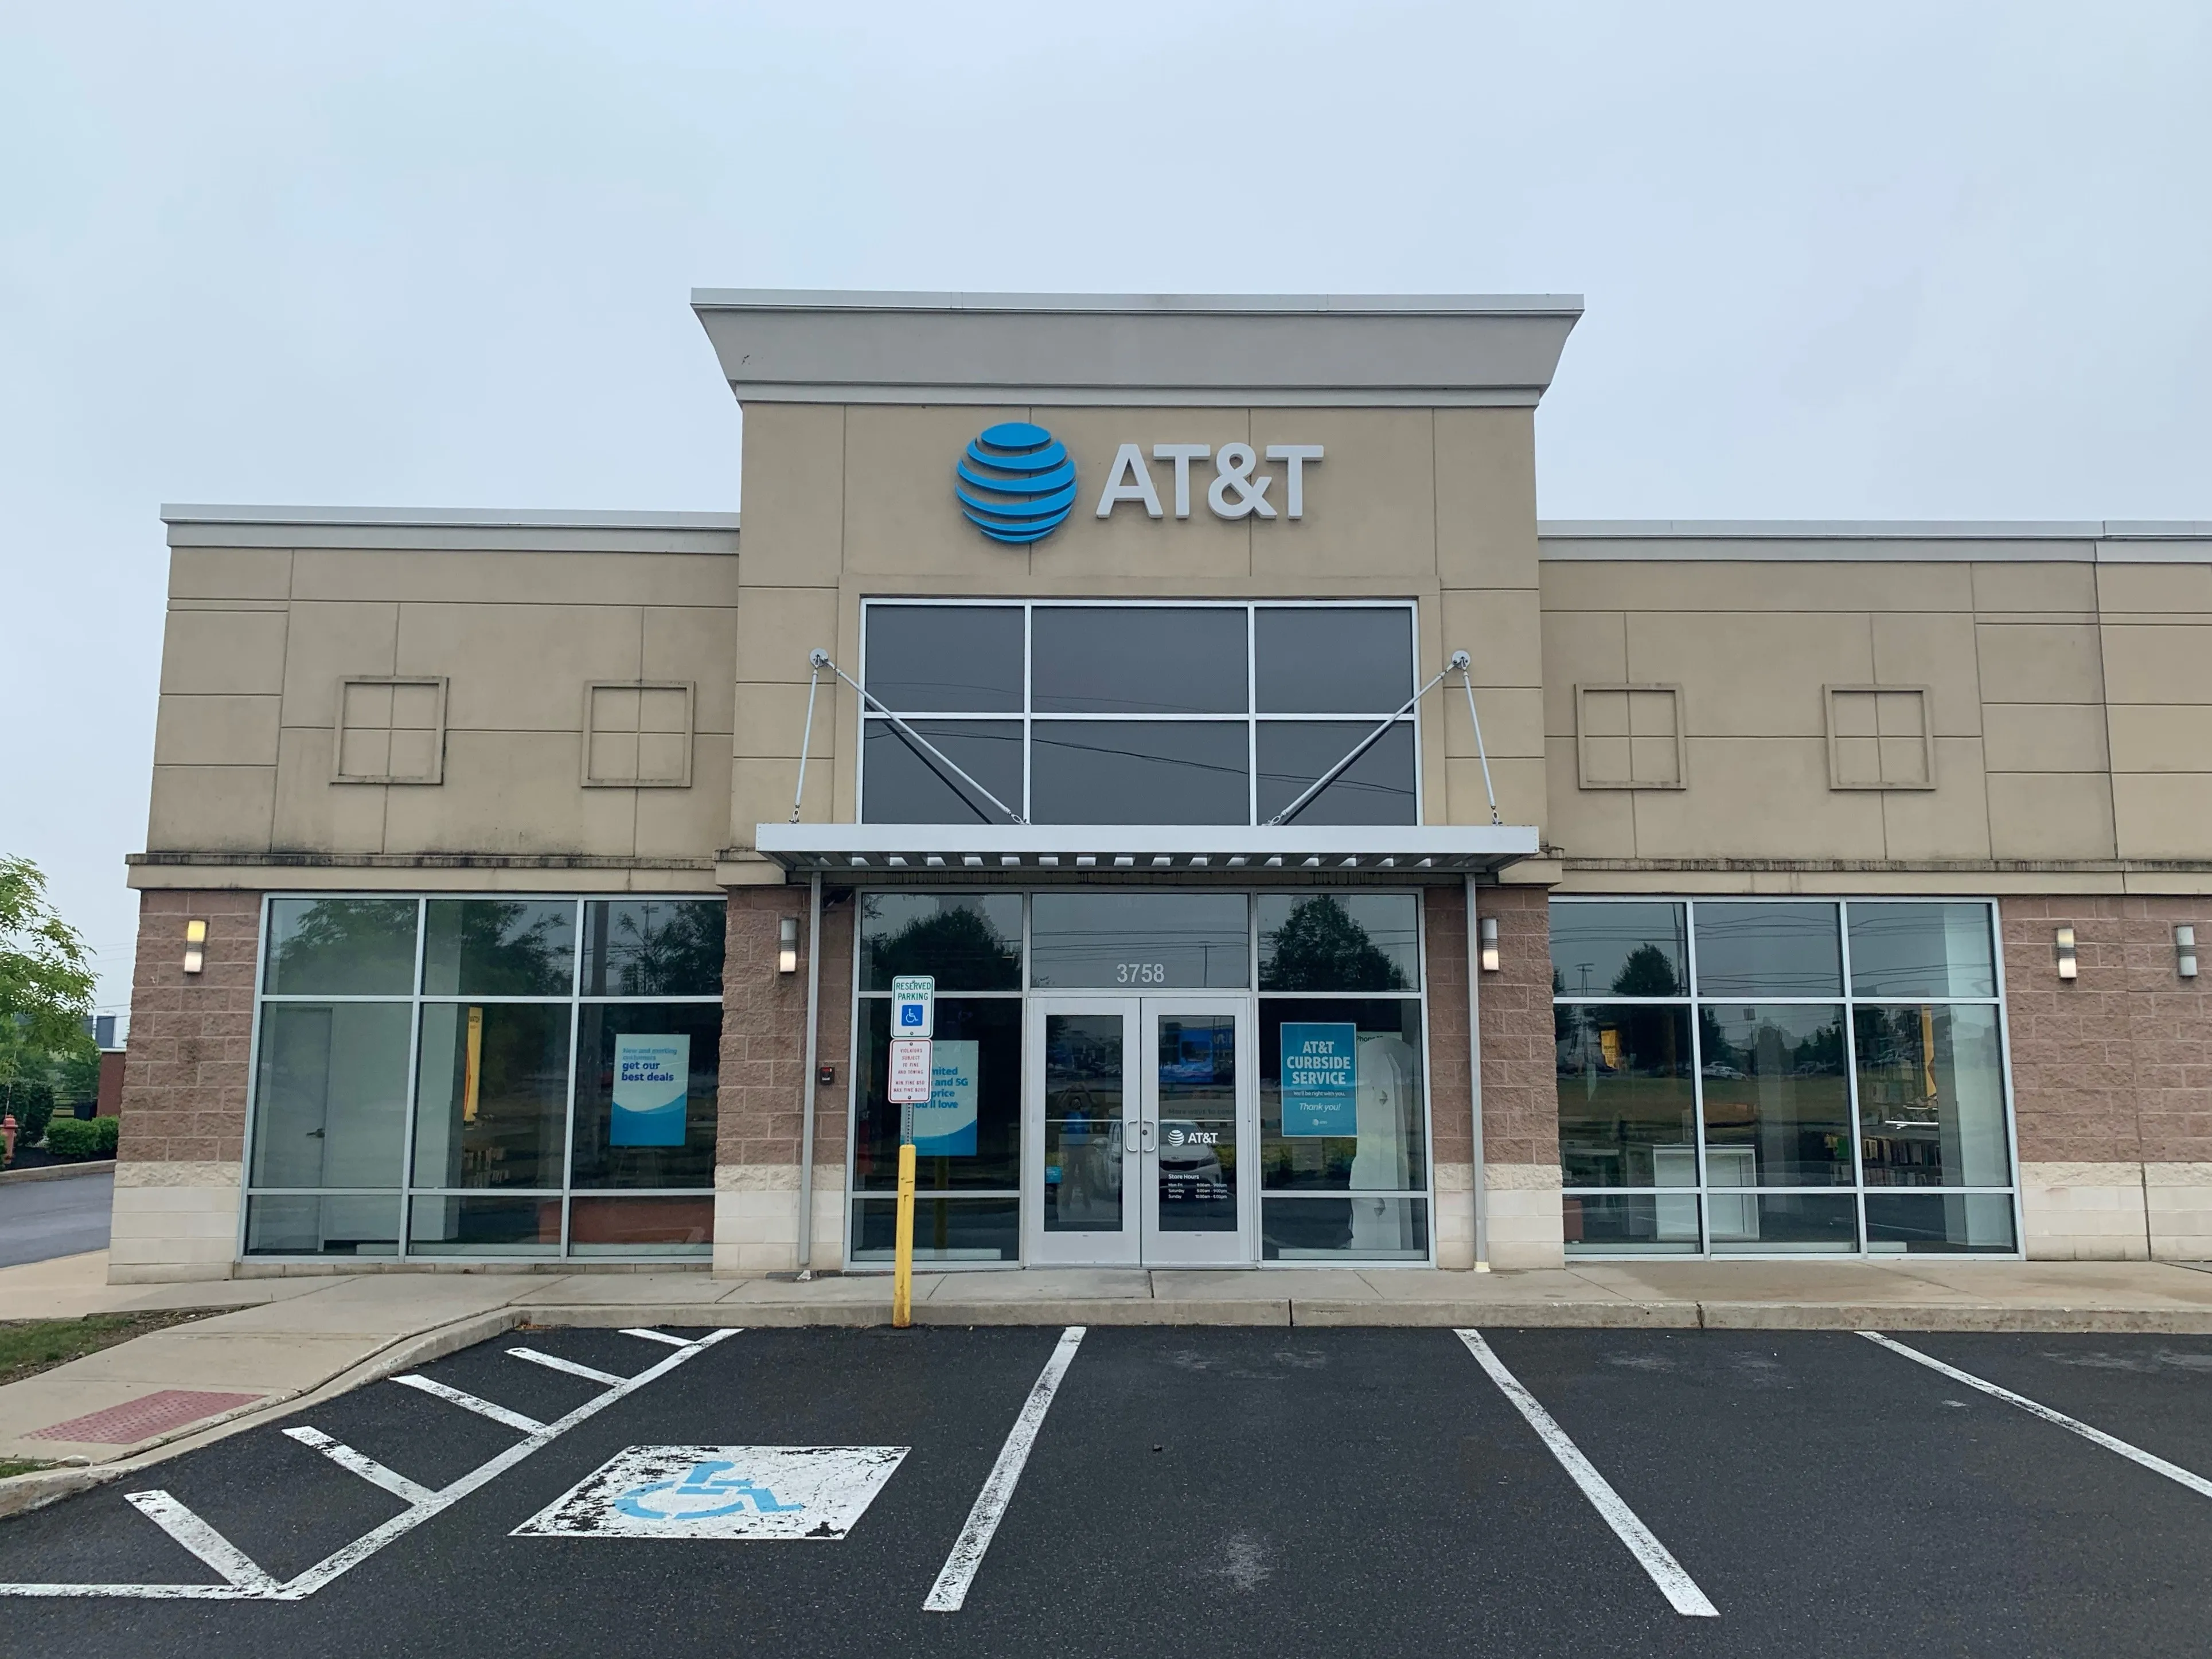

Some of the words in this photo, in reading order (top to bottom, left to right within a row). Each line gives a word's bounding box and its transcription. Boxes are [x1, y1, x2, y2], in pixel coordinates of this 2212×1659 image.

[1096, 442, 1324, 520] AT&T
[1117, 963, 1164, 983] 3758
[898, 993, 929, 1001] PARKING
[1302, 1041, 1335, 1053] AT&T
[622, 1062, 639, 1071] get
[1286, 1056, 1351, 1069] CURBSIDE
[622, 1072, 644, 1081] best
[647, 1072, 674, 1081] deals
[1292, 1071, 1346, 1084] SERVICE
[935, 1078, 953, 1086] and
[955, 1078, 968, 1086] 5G
[931, 1088, 955, 1099] price
[938, 1099, 958, 1108] love
[1299, 1103, 1323, 1111] Thank
[1323, 1103, 1341, 1112] you!
[1188, 1133, 1218, 1143] AT&T
